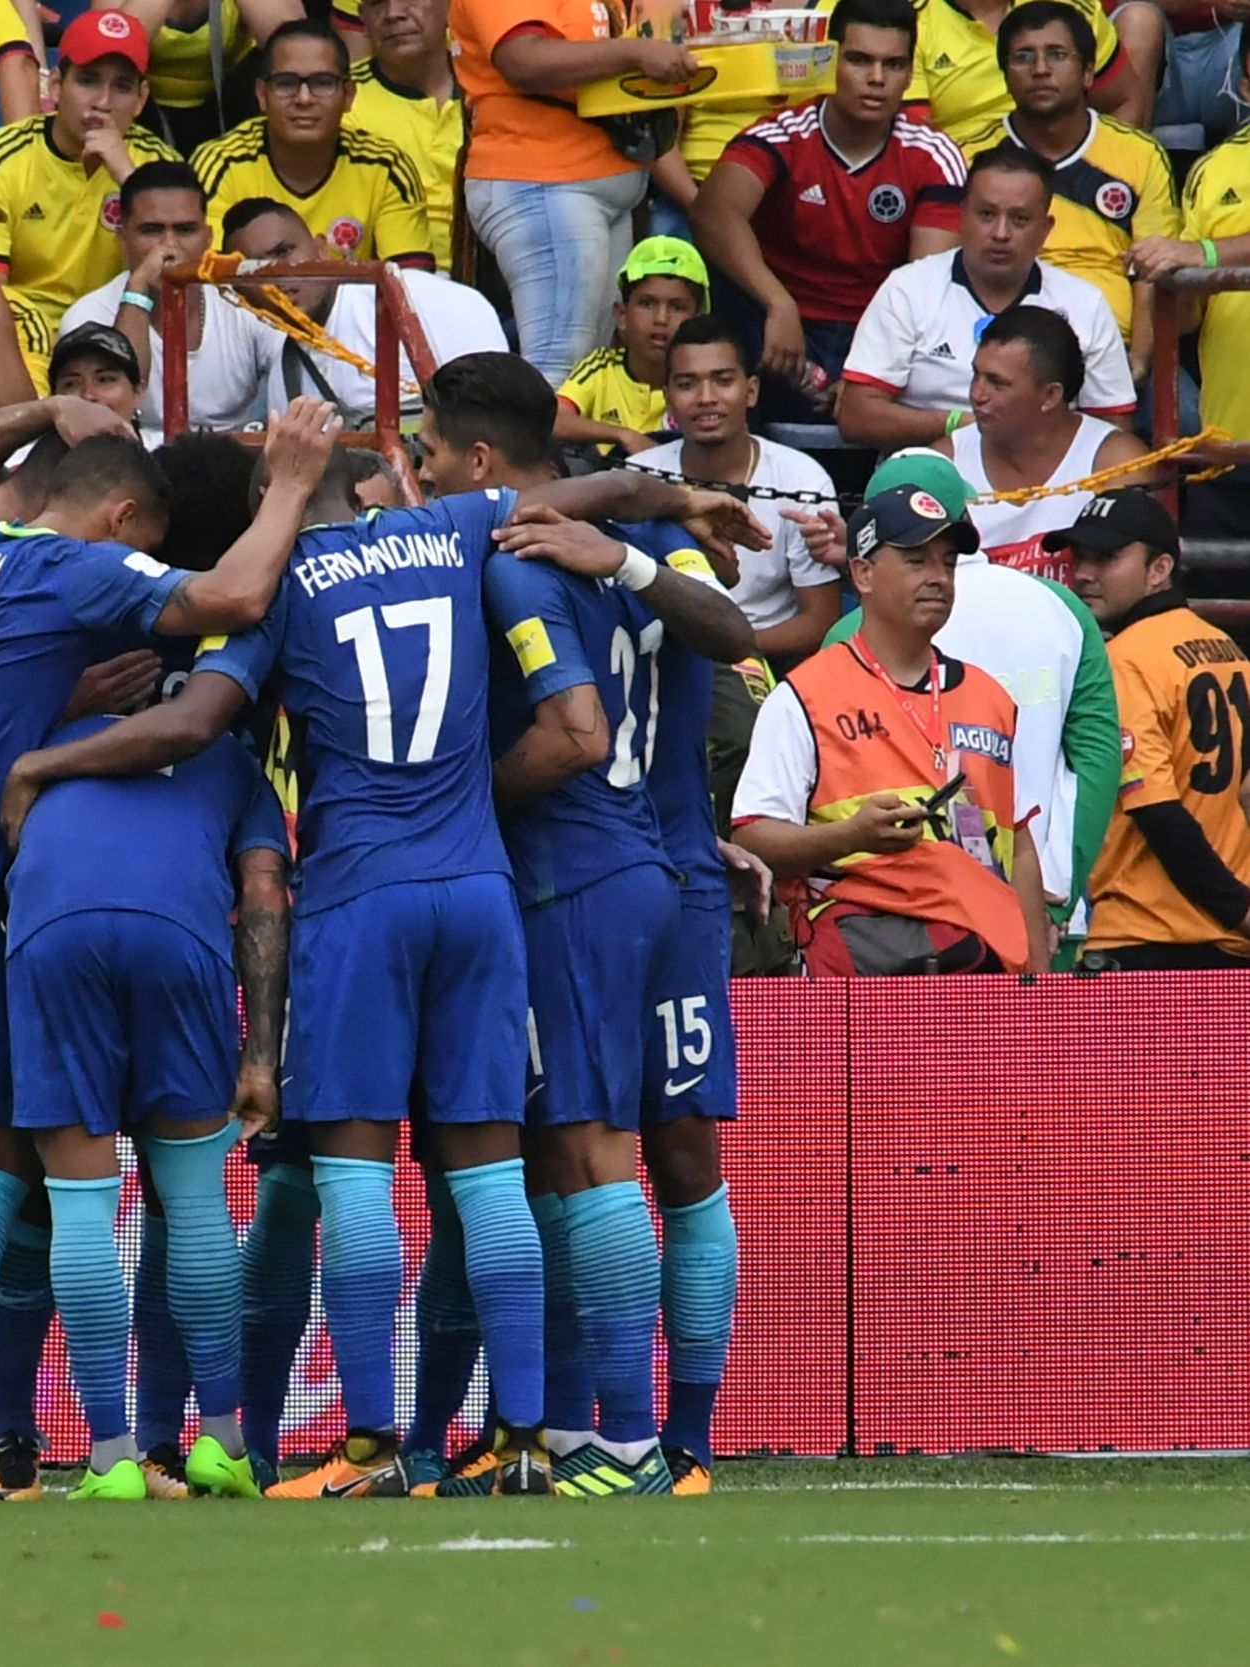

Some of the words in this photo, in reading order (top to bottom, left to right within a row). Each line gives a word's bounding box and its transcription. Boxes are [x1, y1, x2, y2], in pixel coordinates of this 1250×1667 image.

[334, 595, 453, 763] 17
[955, 727, 1008, 761] AGUILA
[656, 995, 712, 1069] 15
